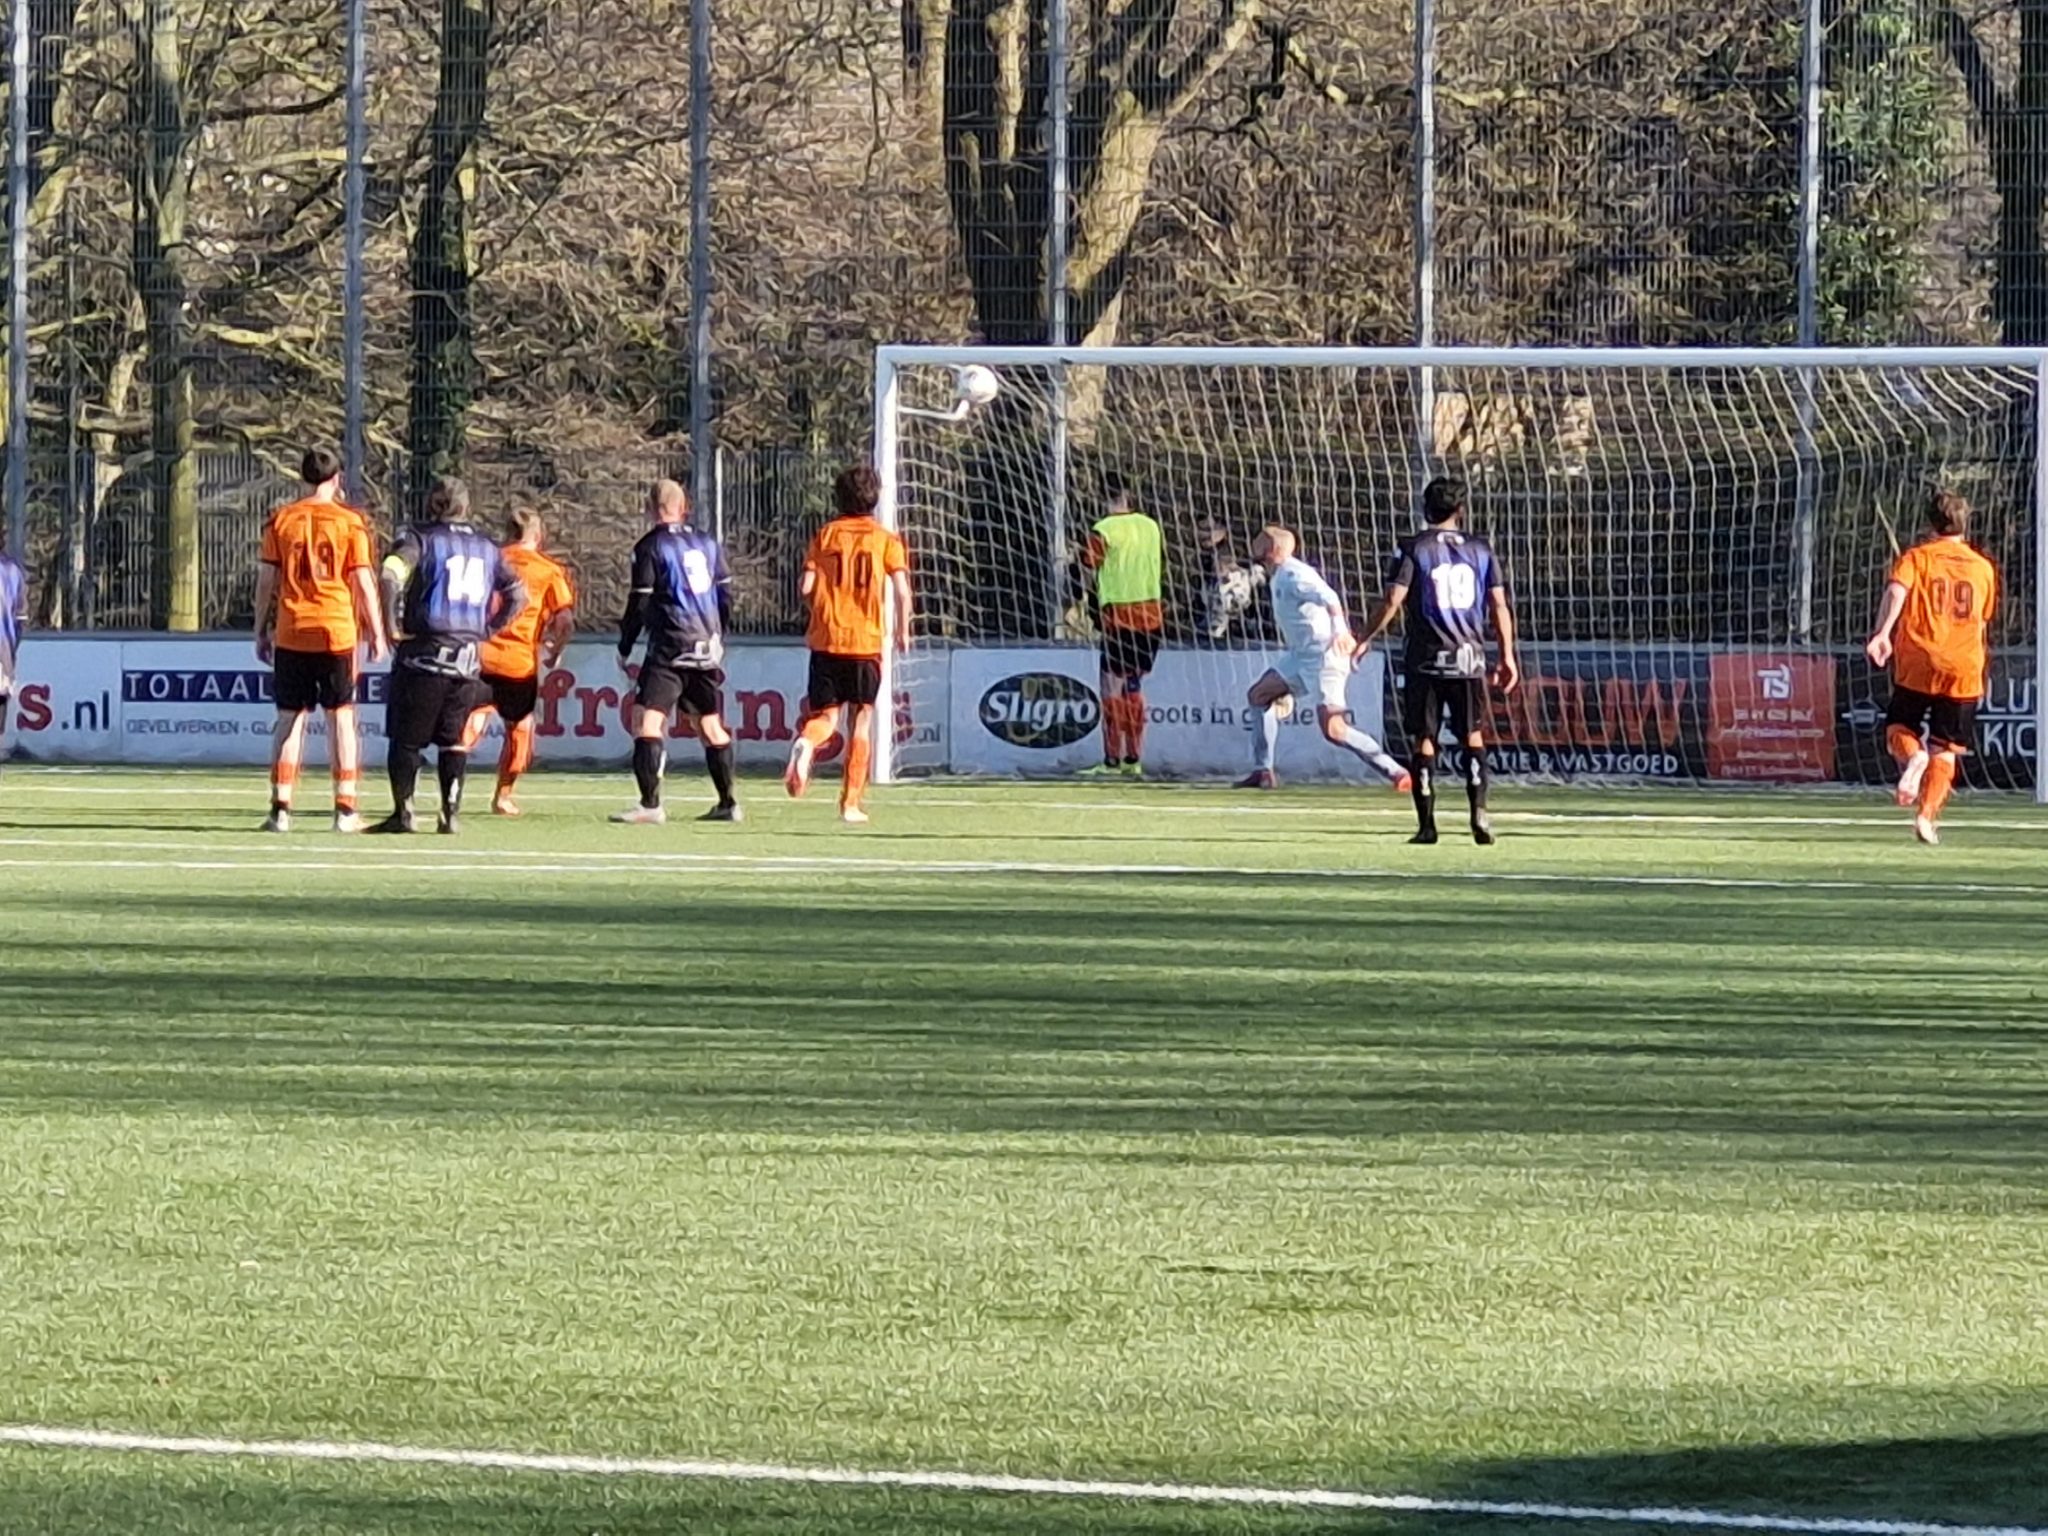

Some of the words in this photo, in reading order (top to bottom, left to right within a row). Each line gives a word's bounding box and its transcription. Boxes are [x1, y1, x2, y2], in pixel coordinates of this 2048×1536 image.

[446, 553, 485, 606] 14
[1931, 576, 1974, 619] 19
[126, 674, 273, 700] TOTAAL
[986, 691, 1097, 731] Sligro
[1211, 702, 1234, 725] in
[1560, 753, 1679, 774] VASTGOED
